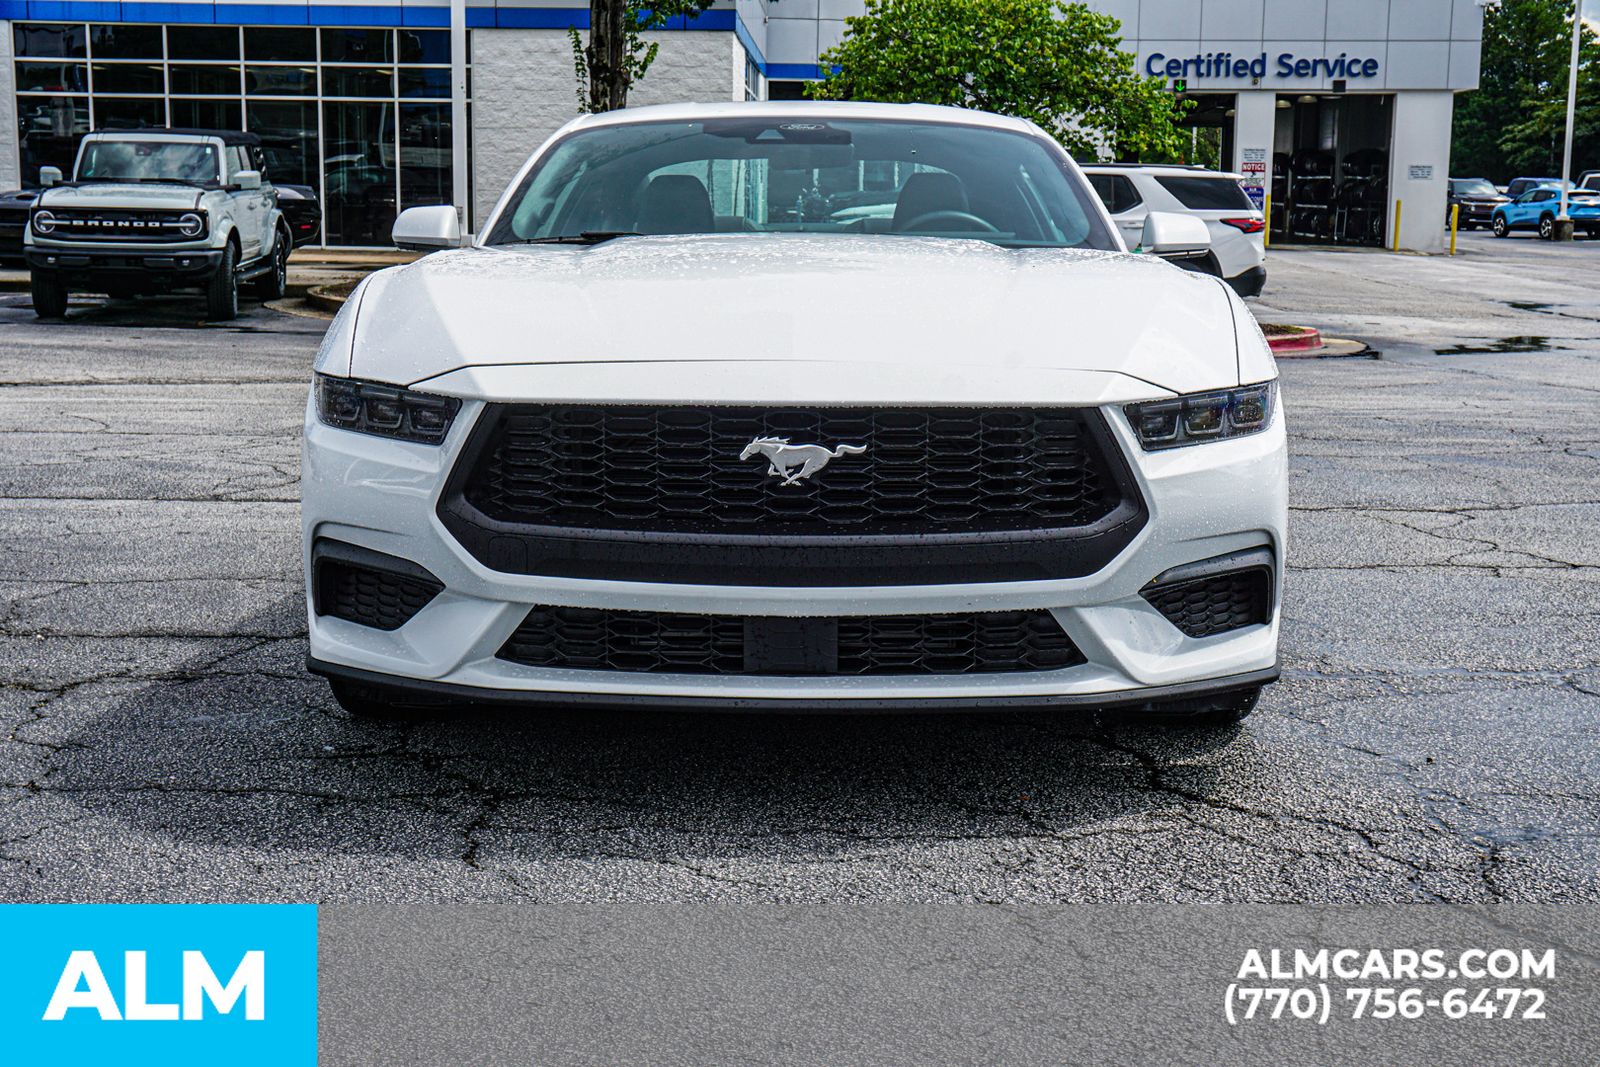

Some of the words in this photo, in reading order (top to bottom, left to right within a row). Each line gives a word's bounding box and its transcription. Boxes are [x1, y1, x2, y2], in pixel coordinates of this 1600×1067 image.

[1146, 53, 1267, 78] Certified
[1276, 53, 1379, 78] Service
[1242, 163, 1265, 171] NOTICE
